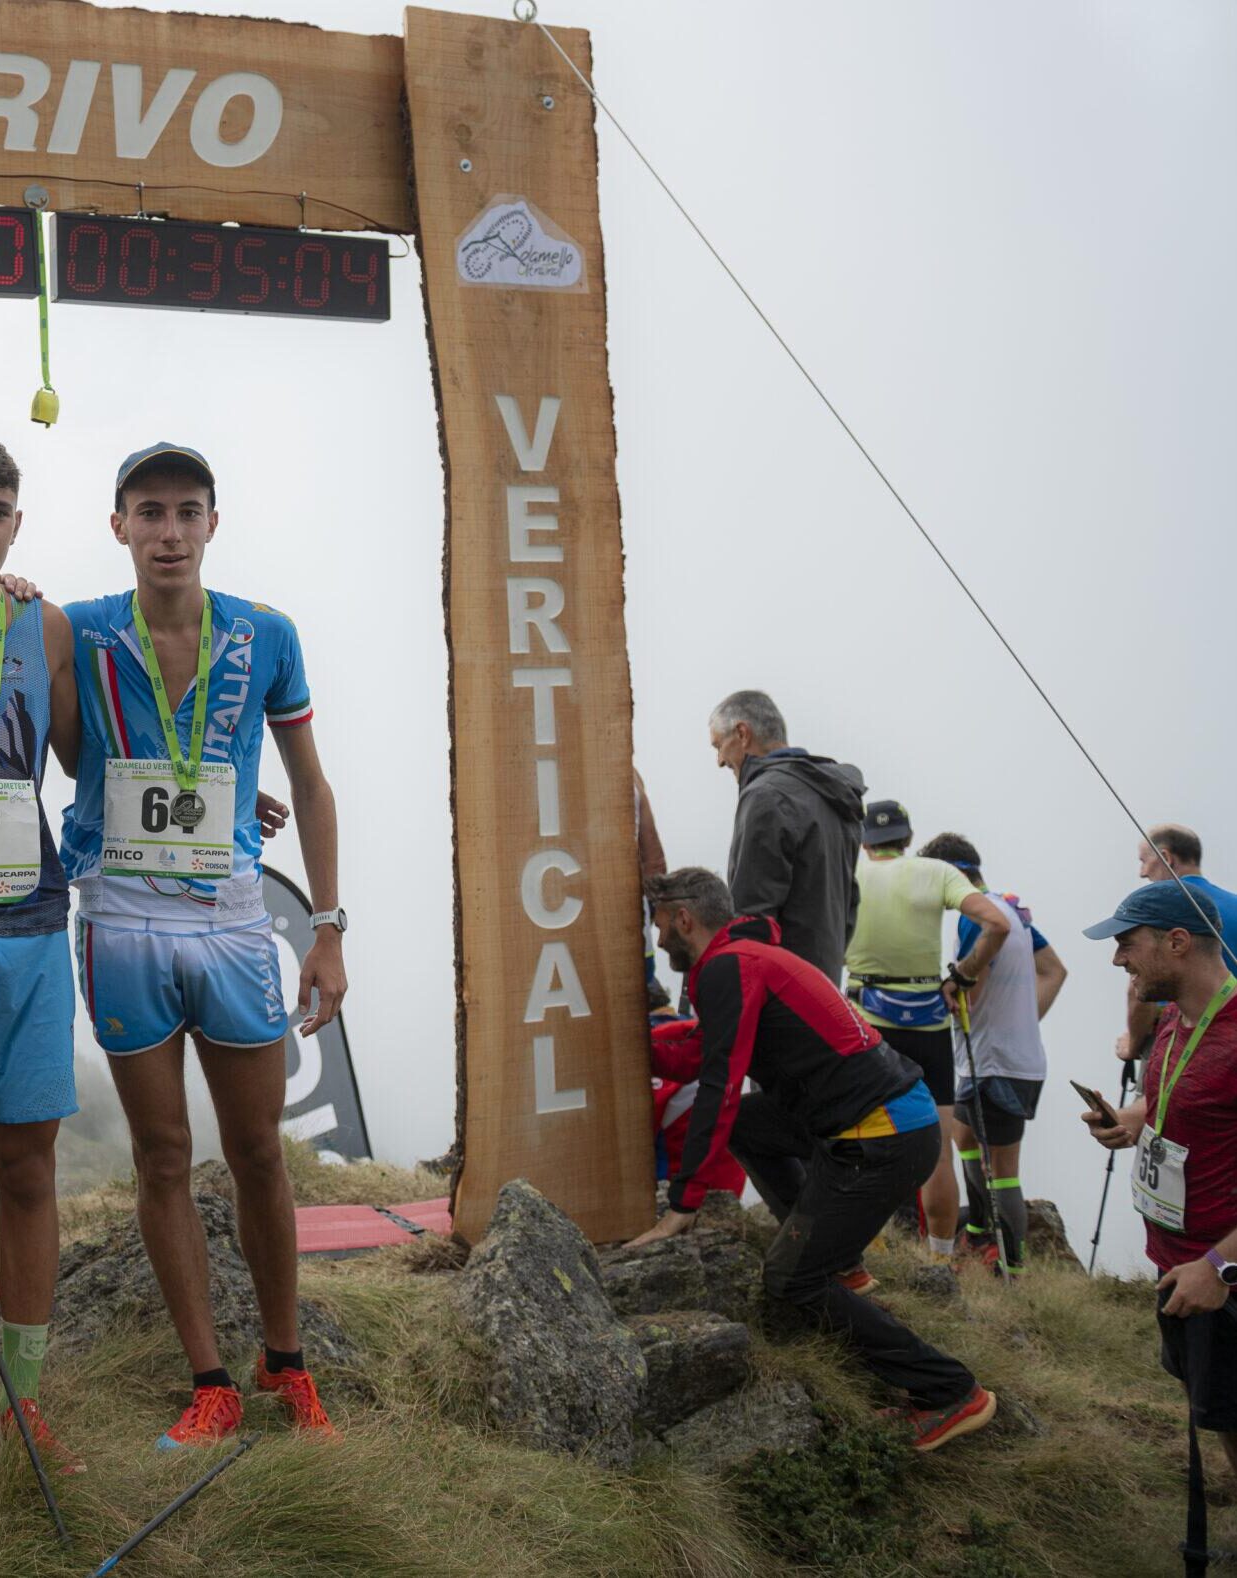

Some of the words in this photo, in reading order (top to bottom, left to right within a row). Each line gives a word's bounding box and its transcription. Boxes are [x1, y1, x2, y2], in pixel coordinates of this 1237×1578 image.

[66, 224, 379, 308] 00:35:04
[202, 643, 252, 759] ITALIA
[113, 762, 152, 770] ADAMELLO
[200, 765, 229, 774] OMETER
[495, 394, 591, 1115] VERTICAL
[104, 849, 144, 860] mico
[192, 849, 230, 857] SCARPA
[1139, 1146, 1161, 1190] 55
